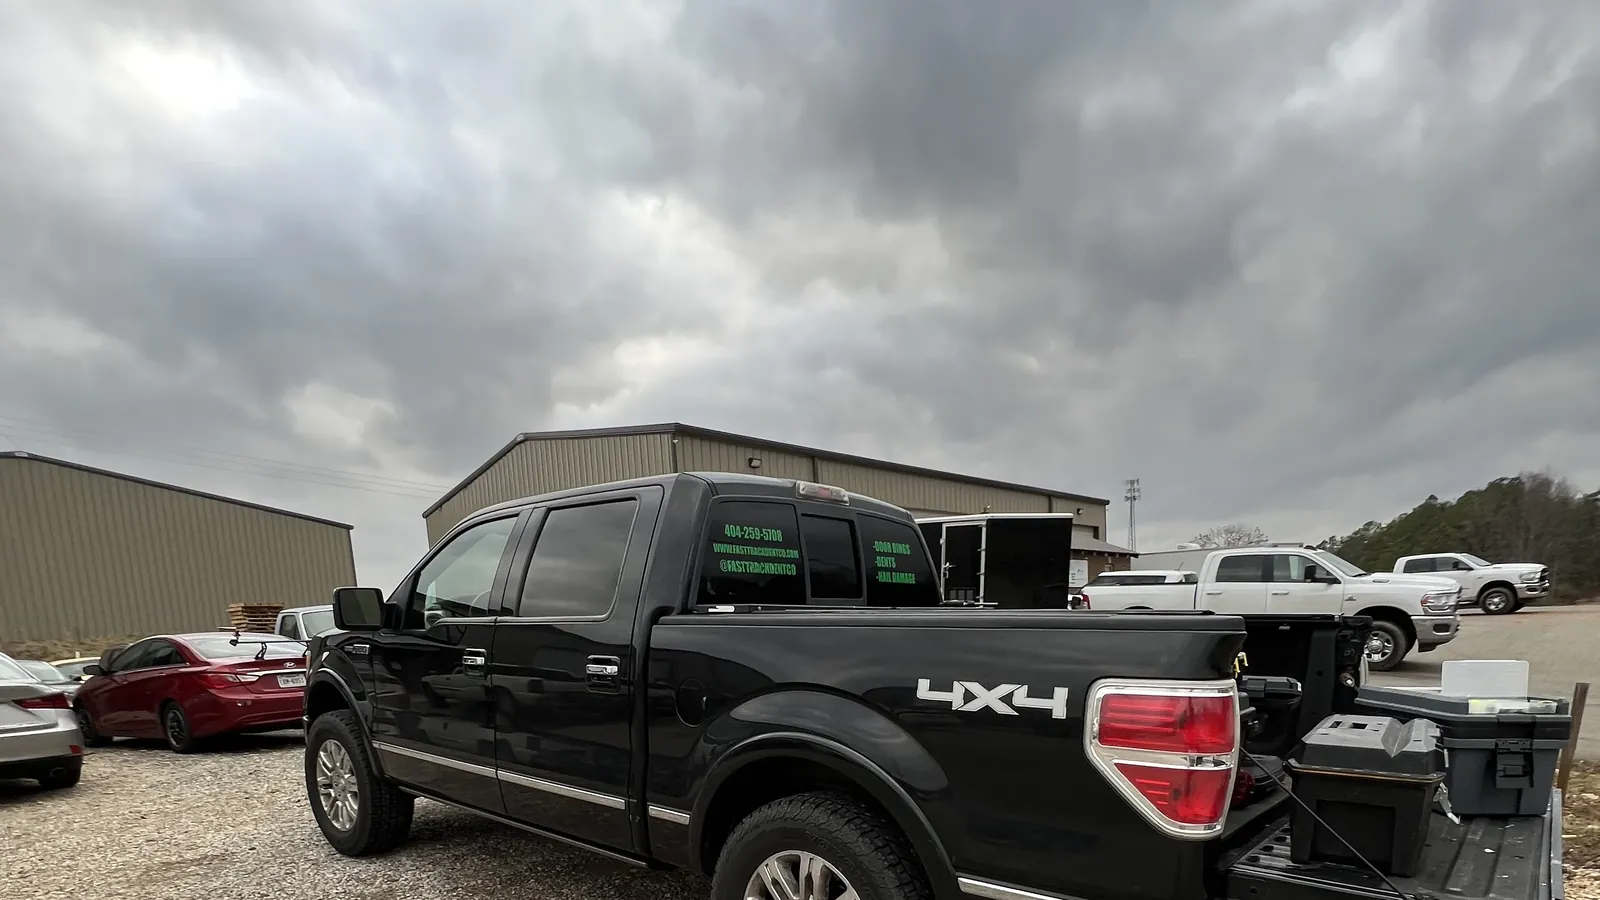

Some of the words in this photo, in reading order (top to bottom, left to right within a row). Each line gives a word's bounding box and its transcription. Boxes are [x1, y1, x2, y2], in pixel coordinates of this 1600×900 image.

[724, 524, 783, 542] 404-259-5708
[892, 542, 911, 555] DINGS
[719, 559, 797, 576] @FASTTRACKDENTCO
[892, 571, 916, 584] DAMAGE
